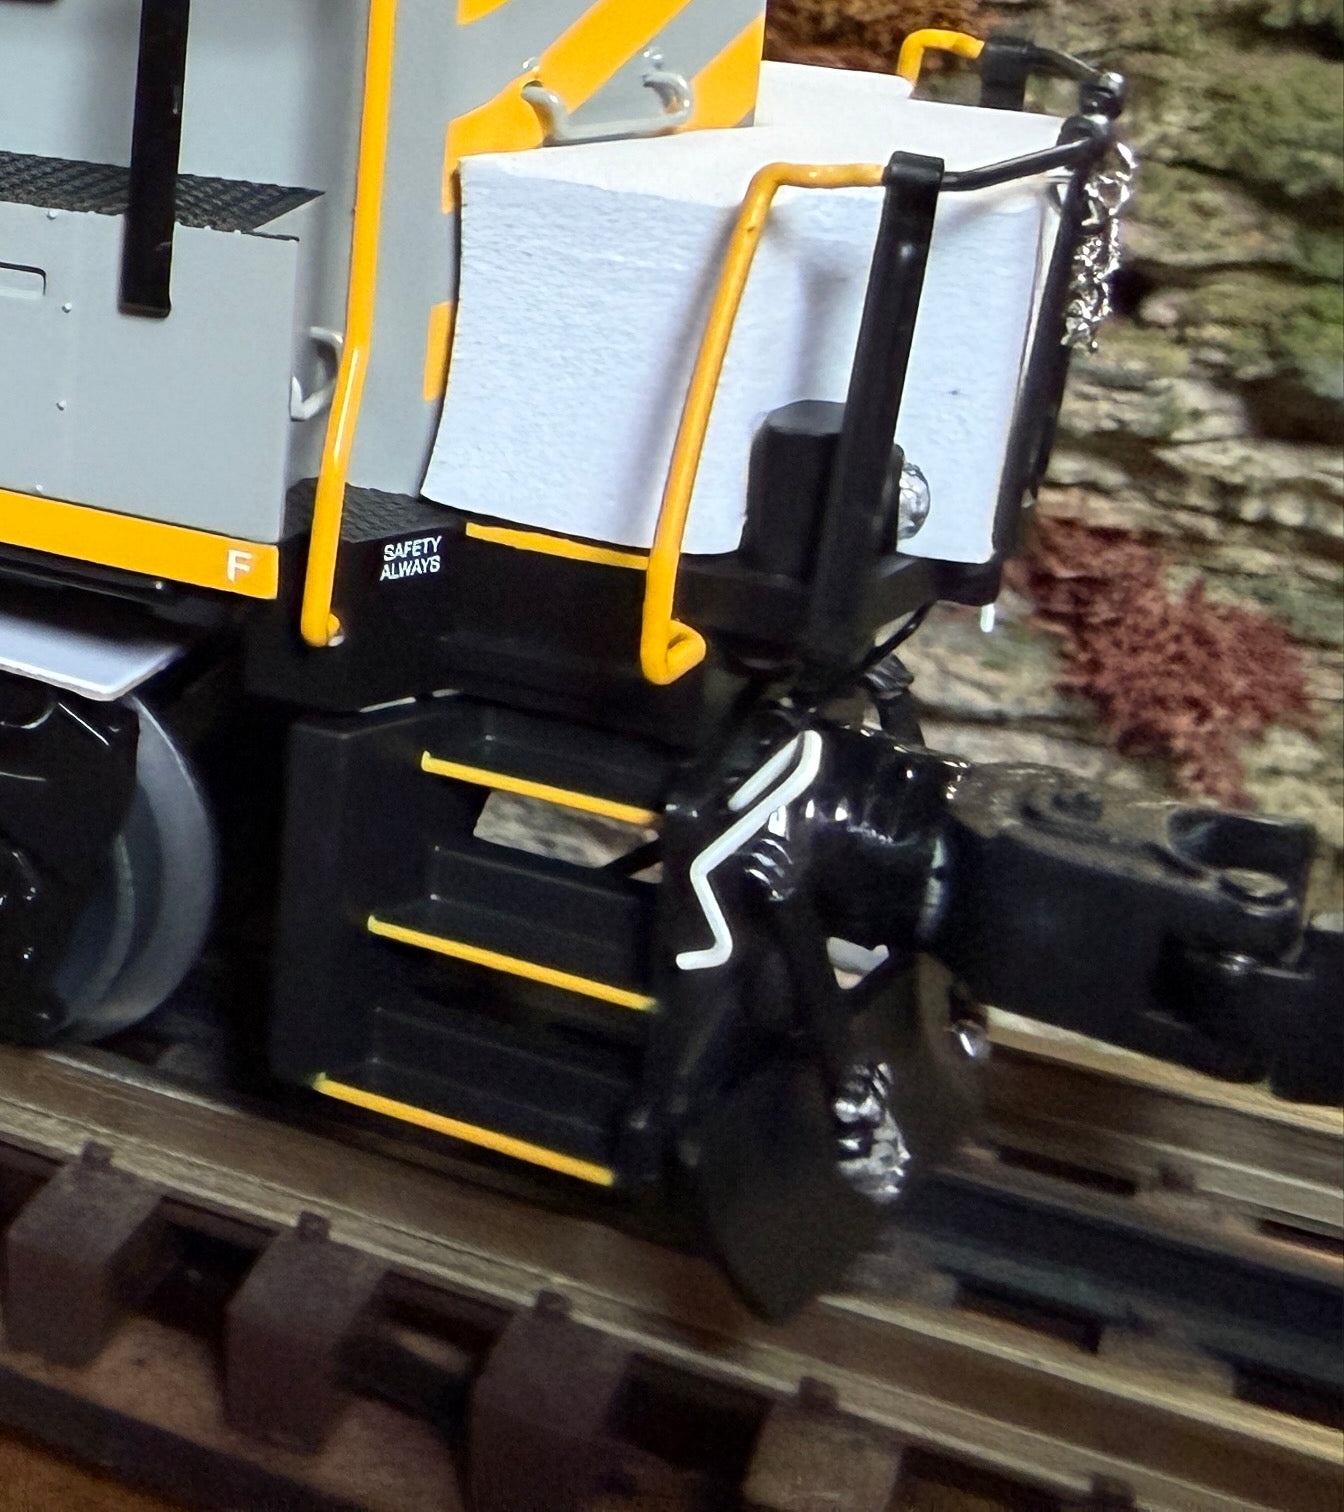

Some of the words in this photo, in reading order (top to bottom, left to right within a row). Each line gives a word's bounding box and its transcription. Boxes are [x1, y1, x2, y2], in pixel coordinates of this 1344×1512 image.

[383, 535, 442, 562] SAFETY
[226, 549, 253, 583] F
[379, 555, 441, 582] ALWAYS
